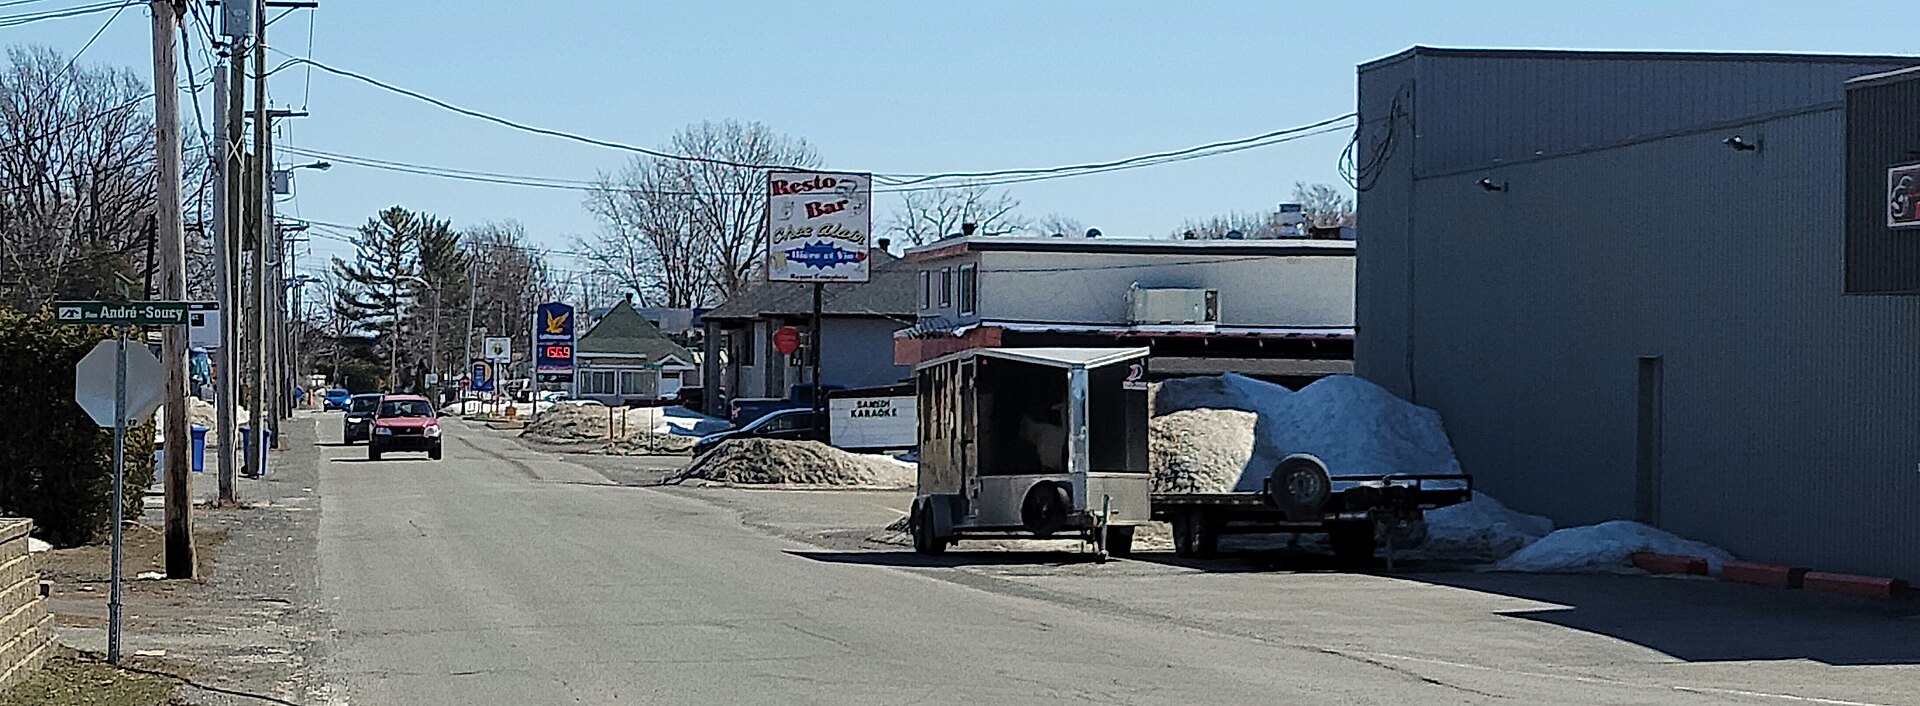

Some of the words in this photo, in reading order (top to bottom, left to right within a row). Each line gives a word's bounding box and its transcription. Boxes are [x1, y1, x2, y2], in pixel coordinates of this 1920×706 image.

[771, 175, 837, 196] Resto
[805, 199, 849, 219] Bar
[100, 305, 184, 321] André-Soucy
[850, 408, 897, 417] KARAOKE
[856, 400, 891, 409] SAMEDI
